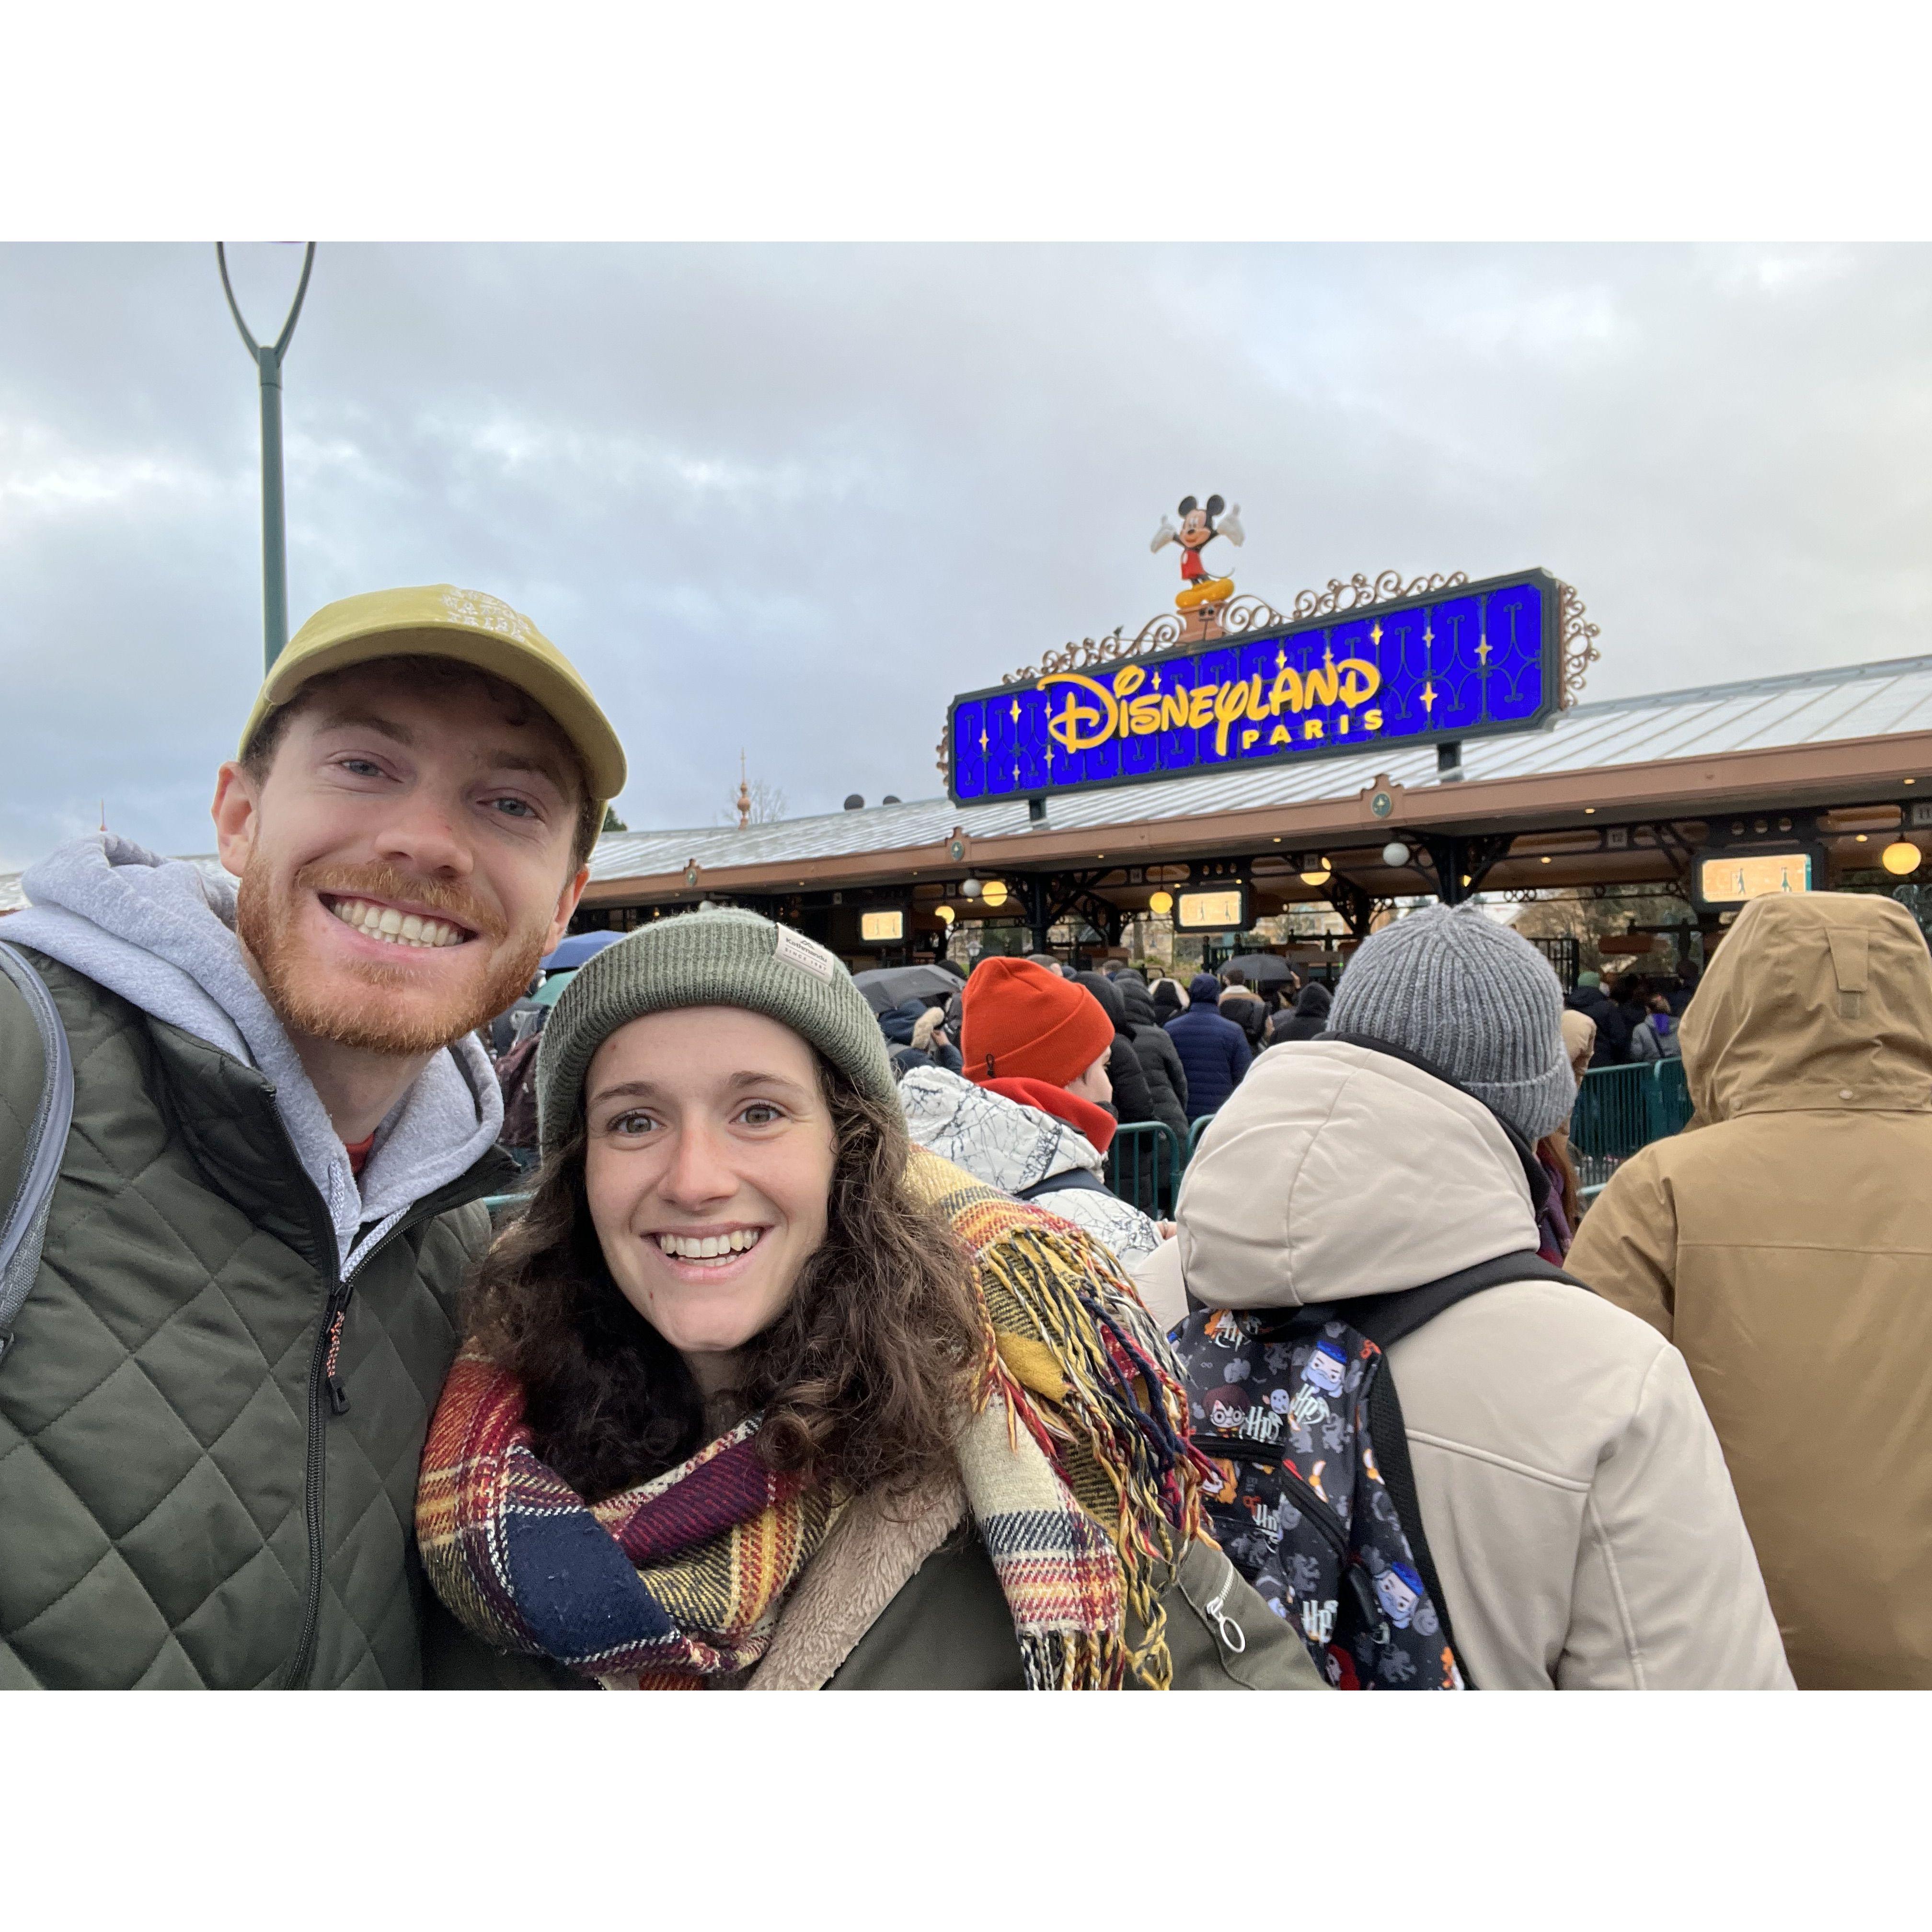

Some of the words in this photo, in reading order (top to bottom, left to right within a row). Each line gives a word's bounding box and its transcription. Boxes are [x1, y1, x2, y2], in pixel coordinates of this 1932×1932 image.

[1242, 709, 1383, 749] PARIS
[784, 947, 807, 961] SINCE
[785, 937, 828, 963] Kathmandu
